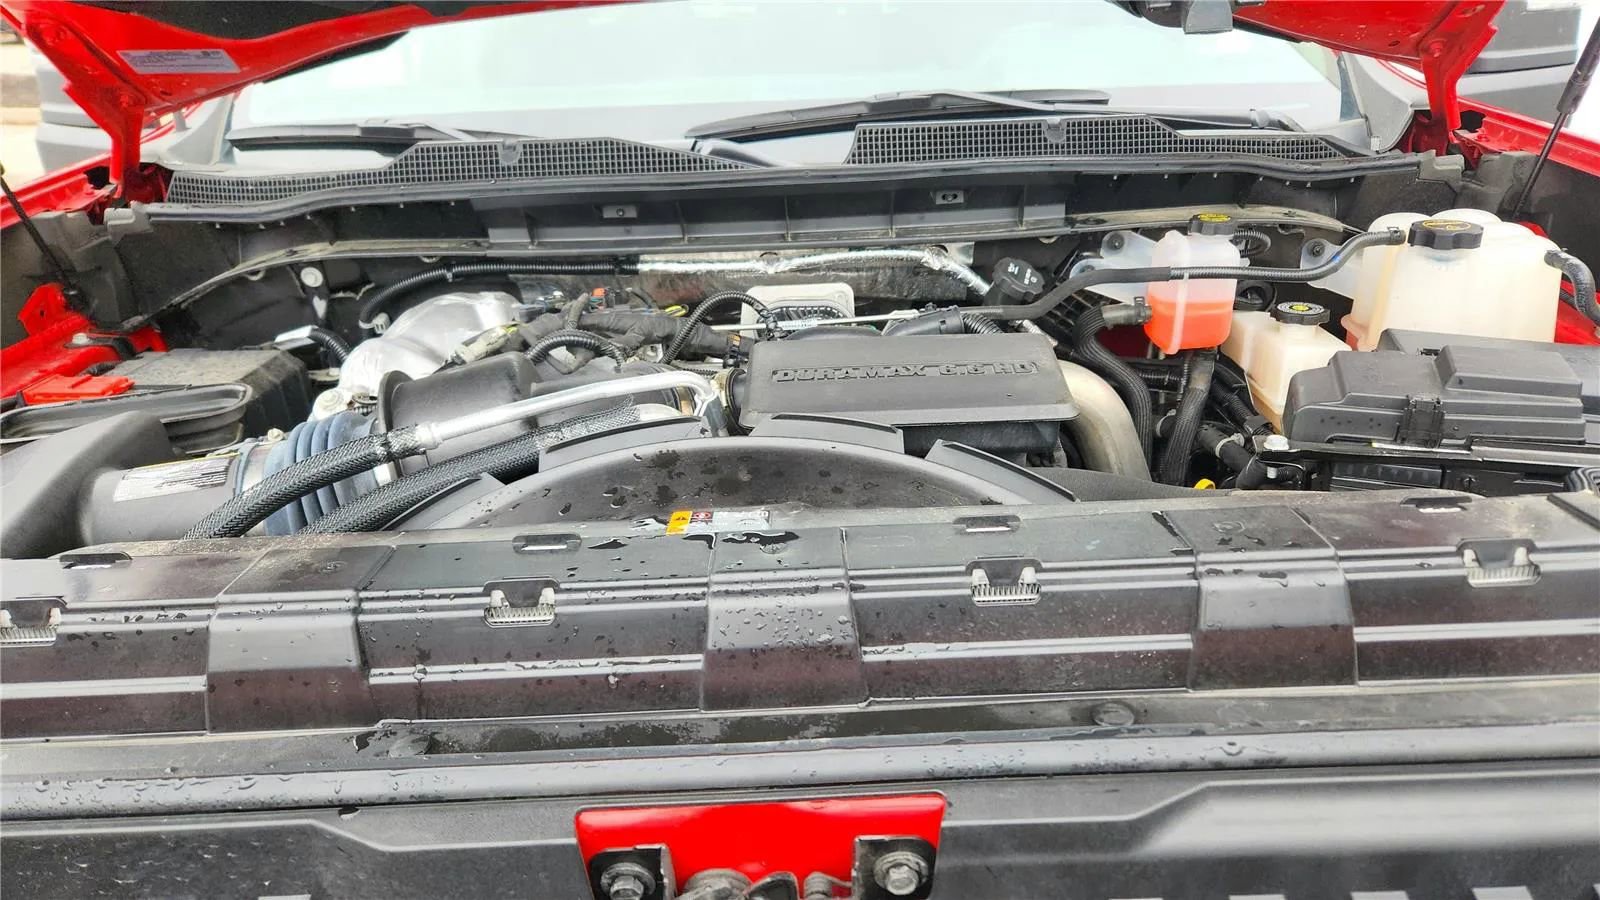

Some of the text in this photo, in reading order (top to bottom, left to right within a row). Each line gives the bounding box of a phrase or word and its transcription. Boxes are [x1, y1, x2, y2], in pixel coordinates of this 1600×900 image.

[774, 361, 1037, 382] DURAMAX 6.6 HD
